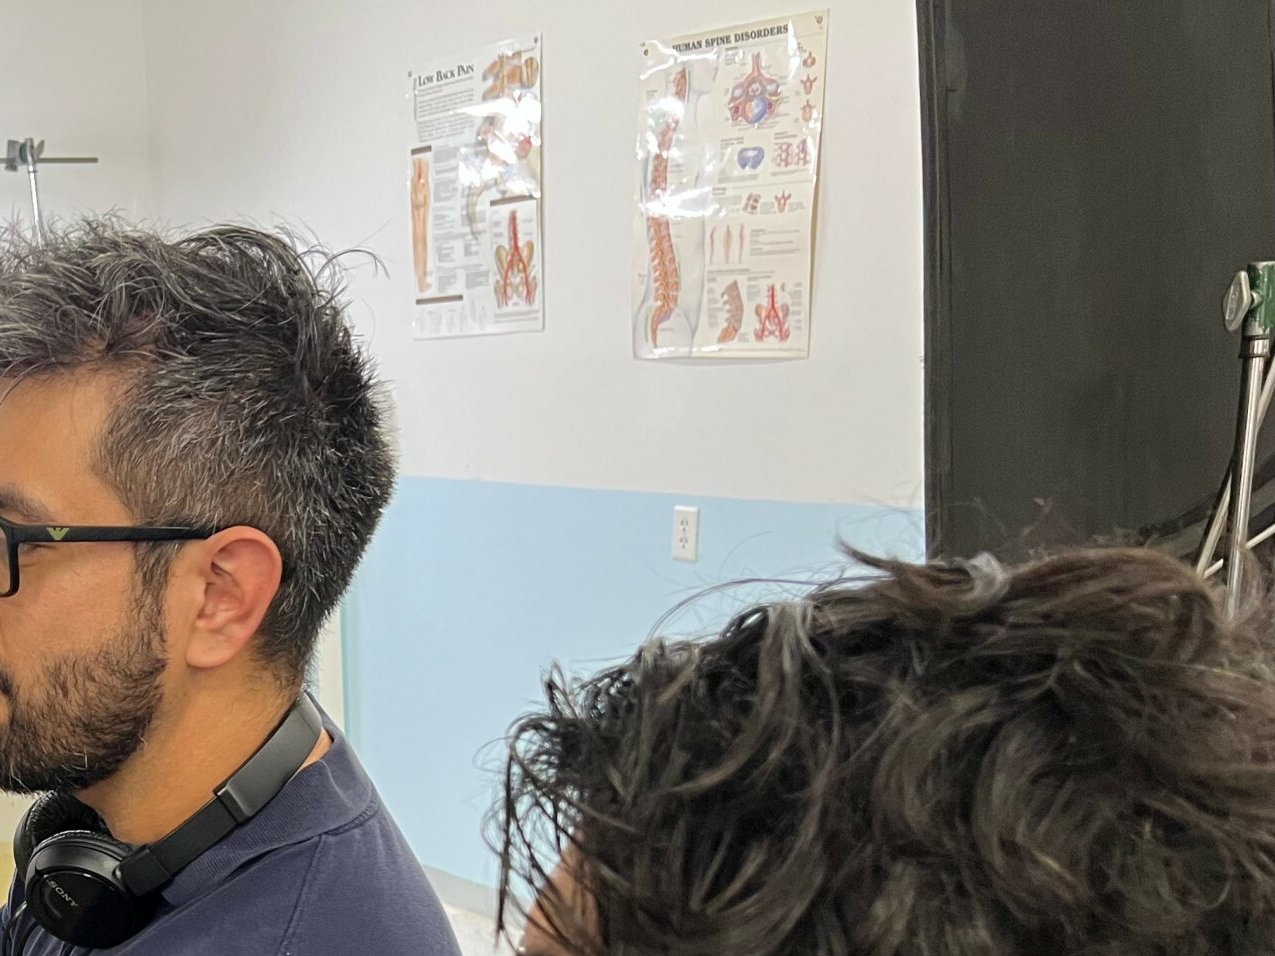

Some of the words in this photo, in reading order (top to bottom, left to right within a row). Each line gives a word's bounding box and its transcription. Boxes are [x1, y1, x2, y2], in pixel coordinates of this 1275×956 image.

[672, 40, 702, 53] HUMAN
[705, 35, 732, 48] SPINE
[734, 24, 788, 42] DISORDERS
